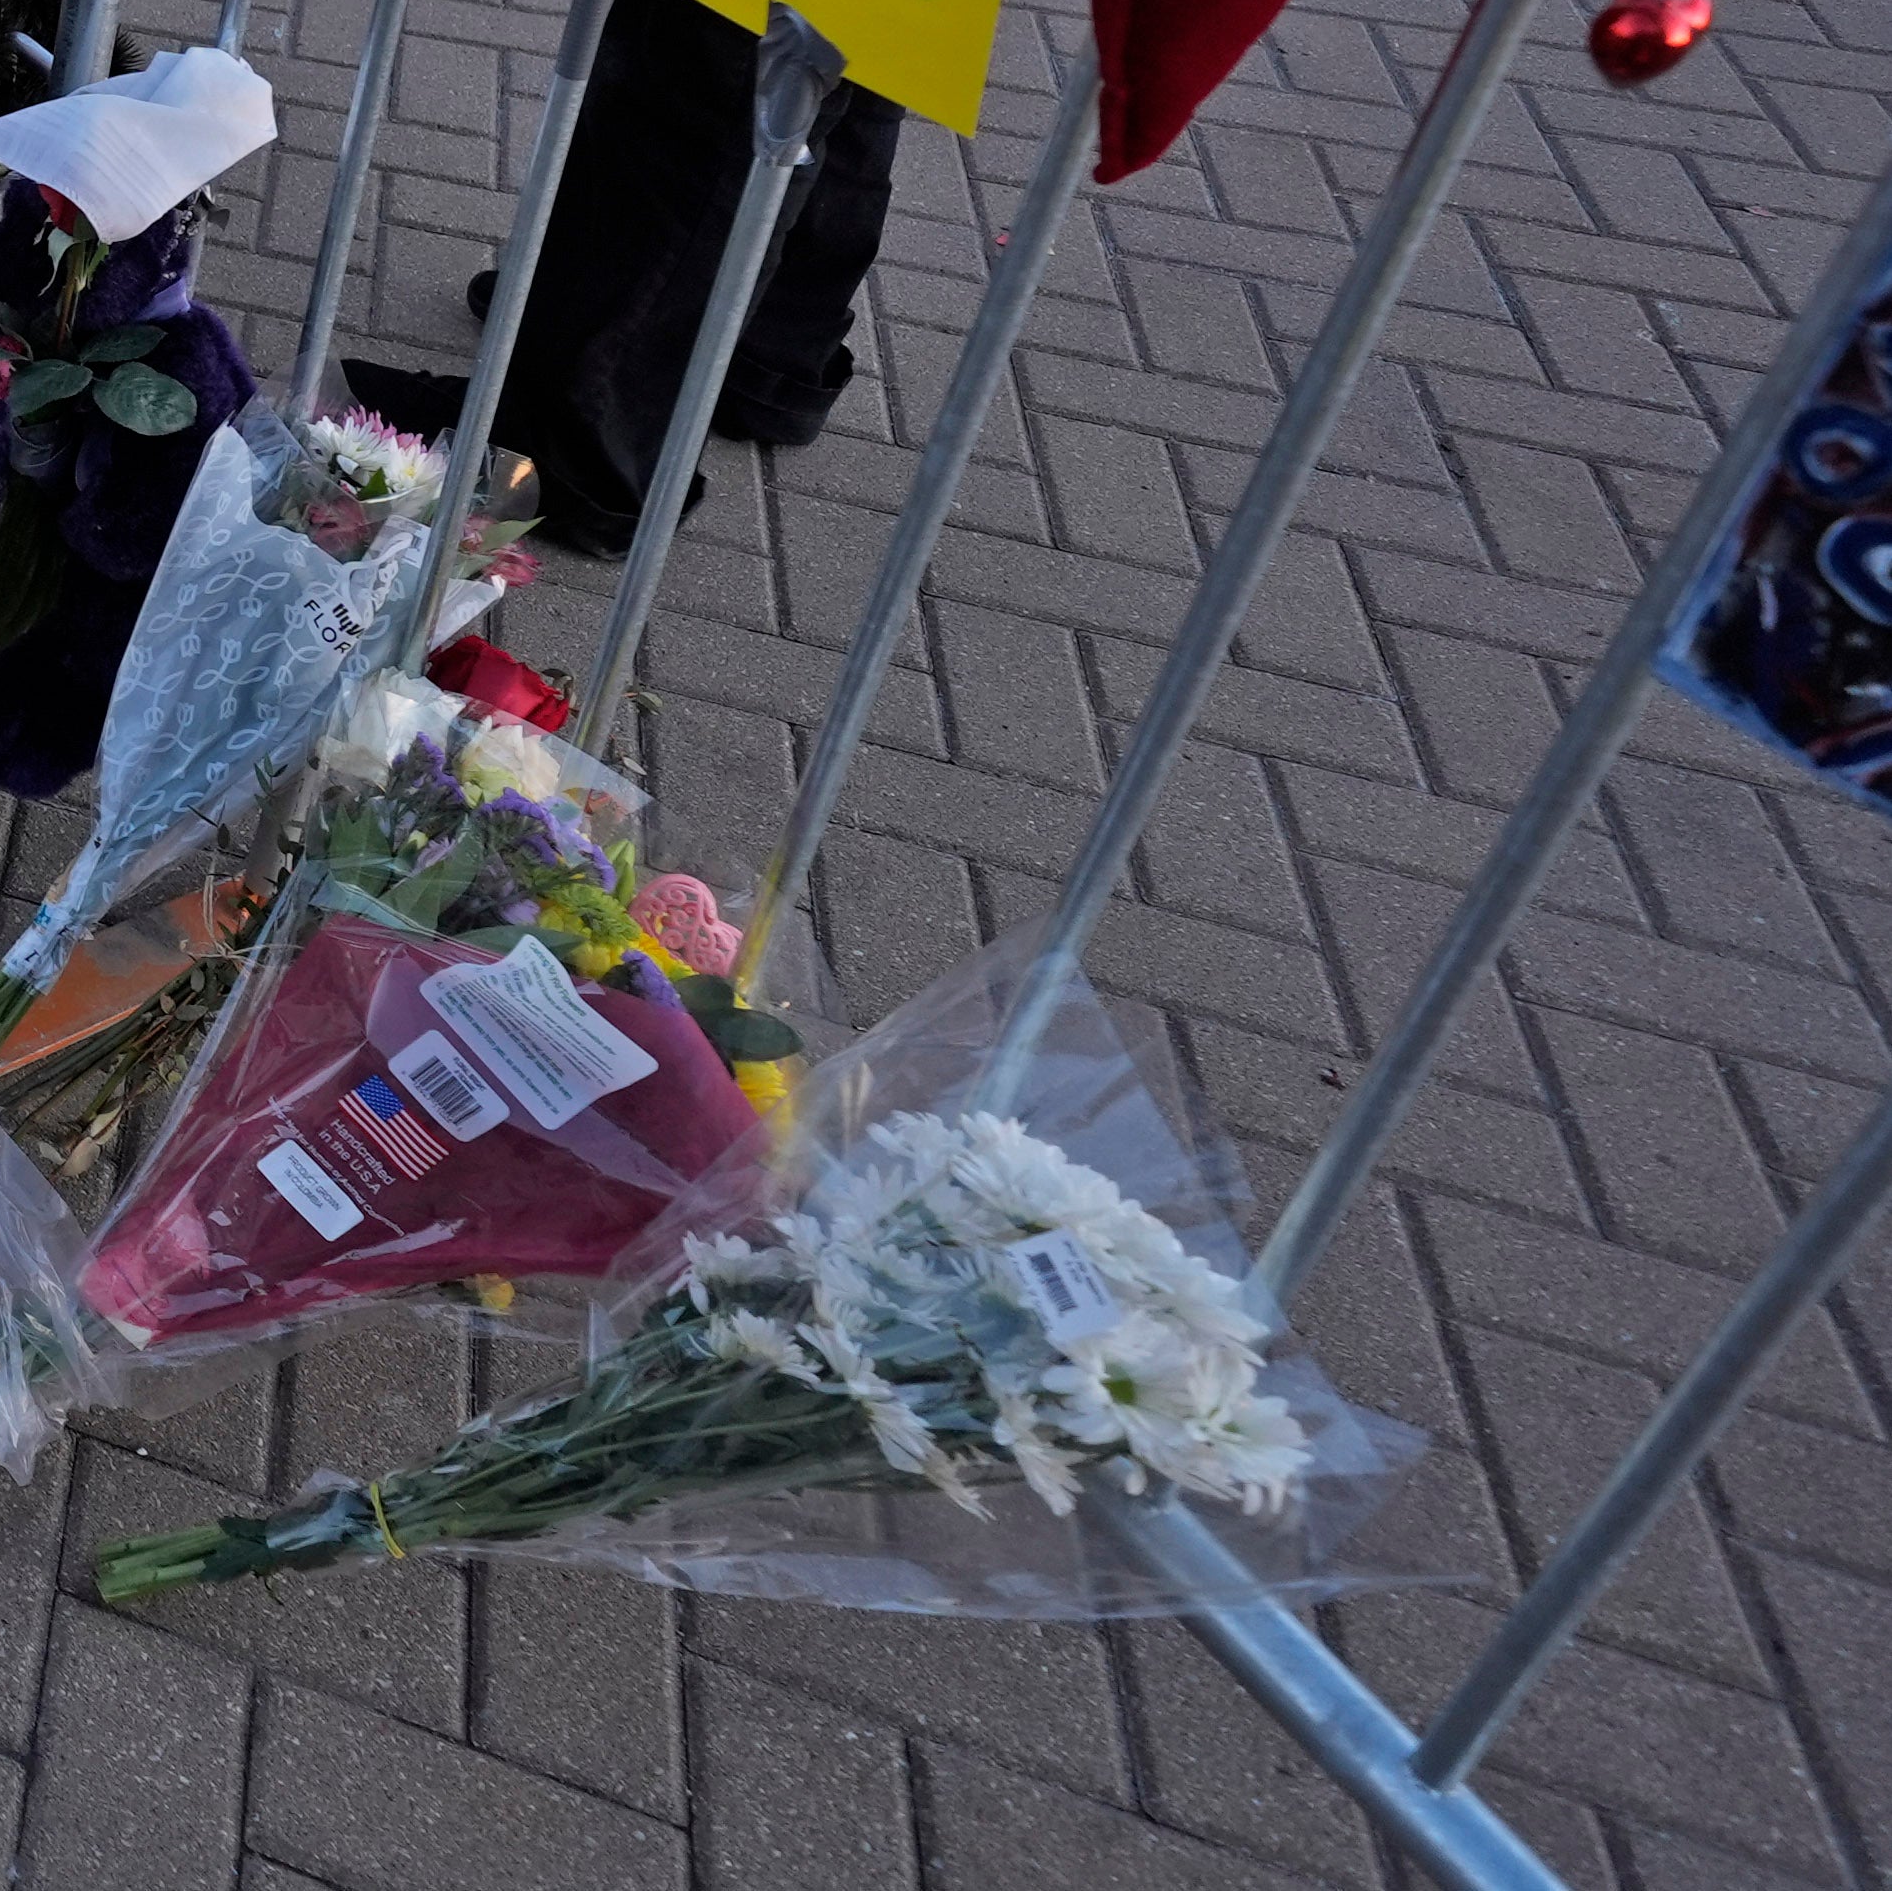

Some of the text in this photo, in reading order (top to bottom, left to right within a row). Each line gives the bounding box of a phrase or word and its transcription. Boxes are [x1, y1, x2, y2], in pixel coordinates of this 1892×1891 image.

[303, 599, 352, 654] FLOR
[330, 1139, 352, 1162] the
[330, 1119, 396, 1186] Handcrafted
